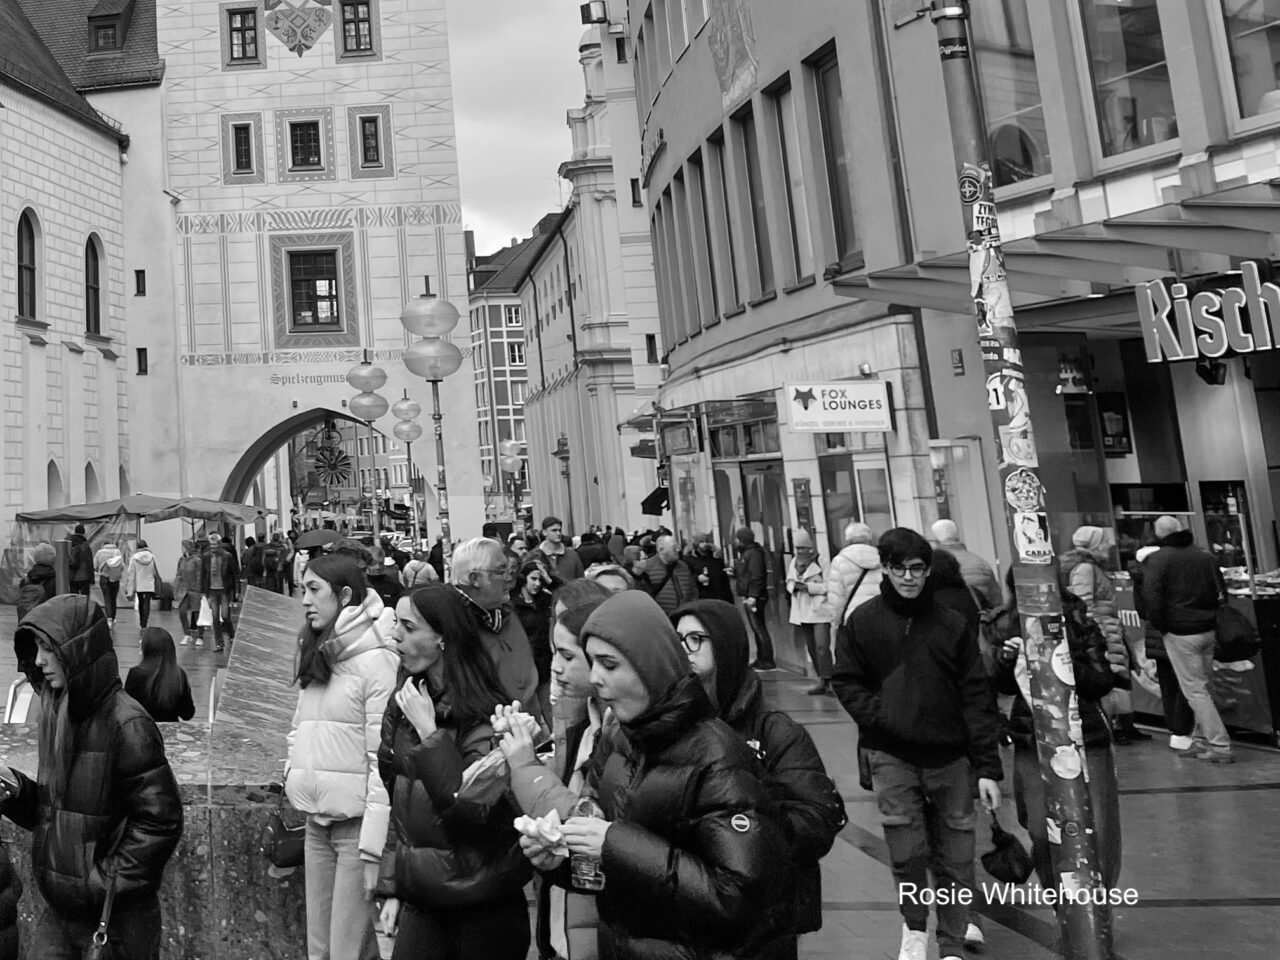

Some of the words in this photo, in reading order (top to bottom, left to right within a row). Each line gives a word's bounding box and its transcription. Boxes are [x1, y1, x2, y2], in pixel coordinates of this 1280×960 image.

[270, 372, 349, 386] Spielzeugmus
[821, 389, 848, 399] FOX
[822, 399, 883, 411] LOUNGES
